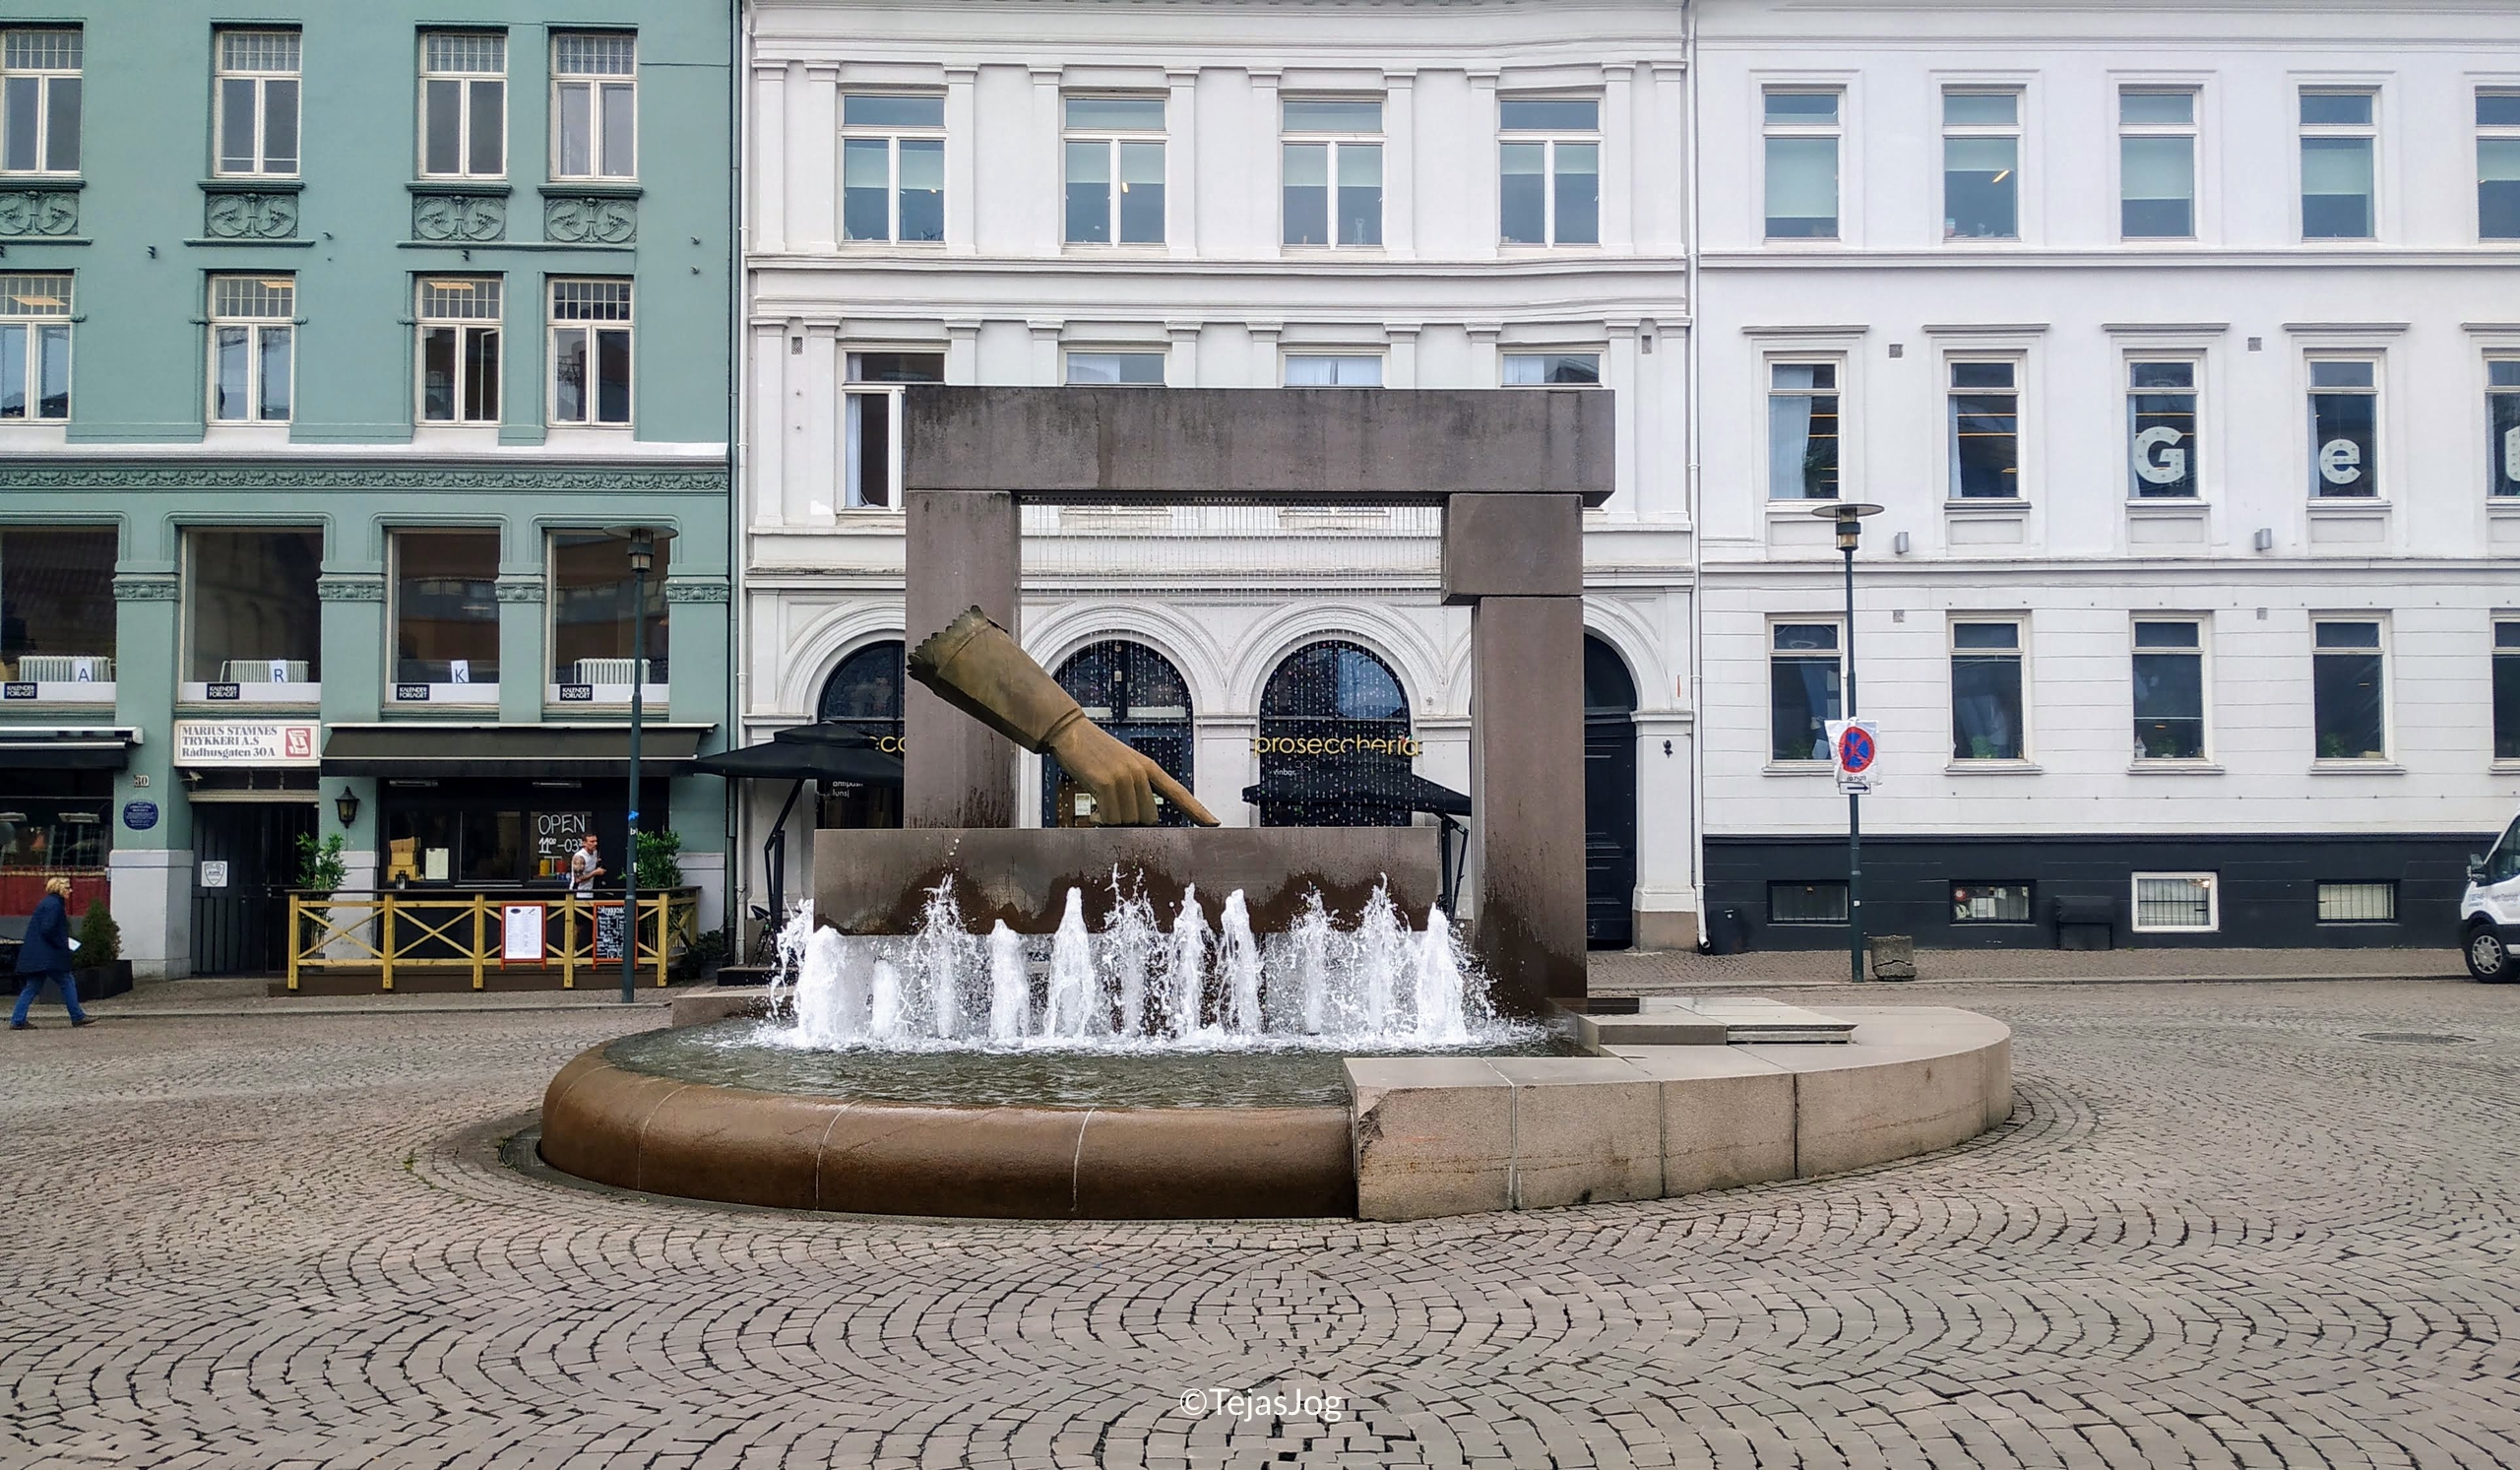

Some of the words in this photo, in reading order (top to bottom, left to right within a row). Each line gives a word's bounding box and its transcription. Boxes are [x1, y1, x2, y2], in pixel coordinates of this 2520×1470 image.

[2133, 426, 2185, 483] G
[78, 668, 91, 682] A
[274, 669, 284, 682] R
[455, 669, 466, 682] K
[182, 727, 224, 735] MARIUS
[227, 727, 278, 735] STAMNES
[182, 736, 239, 745] TRYKKERI
[181, 747, 251, 758] Rådhusgaten
[537, 814, 586, 835] OPEN
